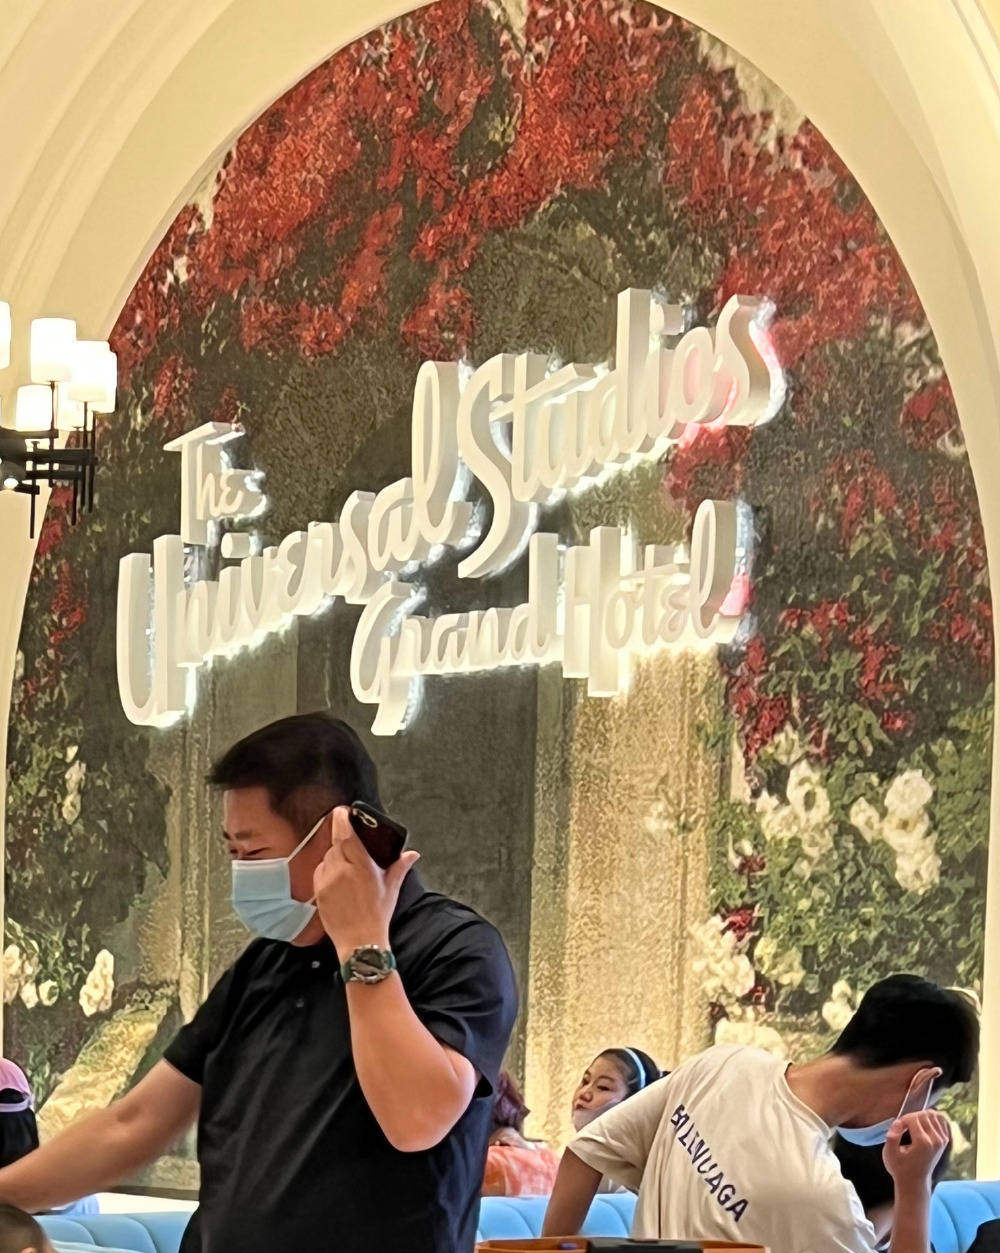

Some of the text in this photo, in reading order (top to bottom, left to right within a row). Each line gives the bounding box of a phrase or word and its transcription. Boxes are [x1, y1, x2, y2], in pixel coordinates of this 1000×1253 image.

[116, 287, 786, 728] Universal Studios
[163, 422, 264, 545] The
[350, 499, 750, 736] Grand Hotel
